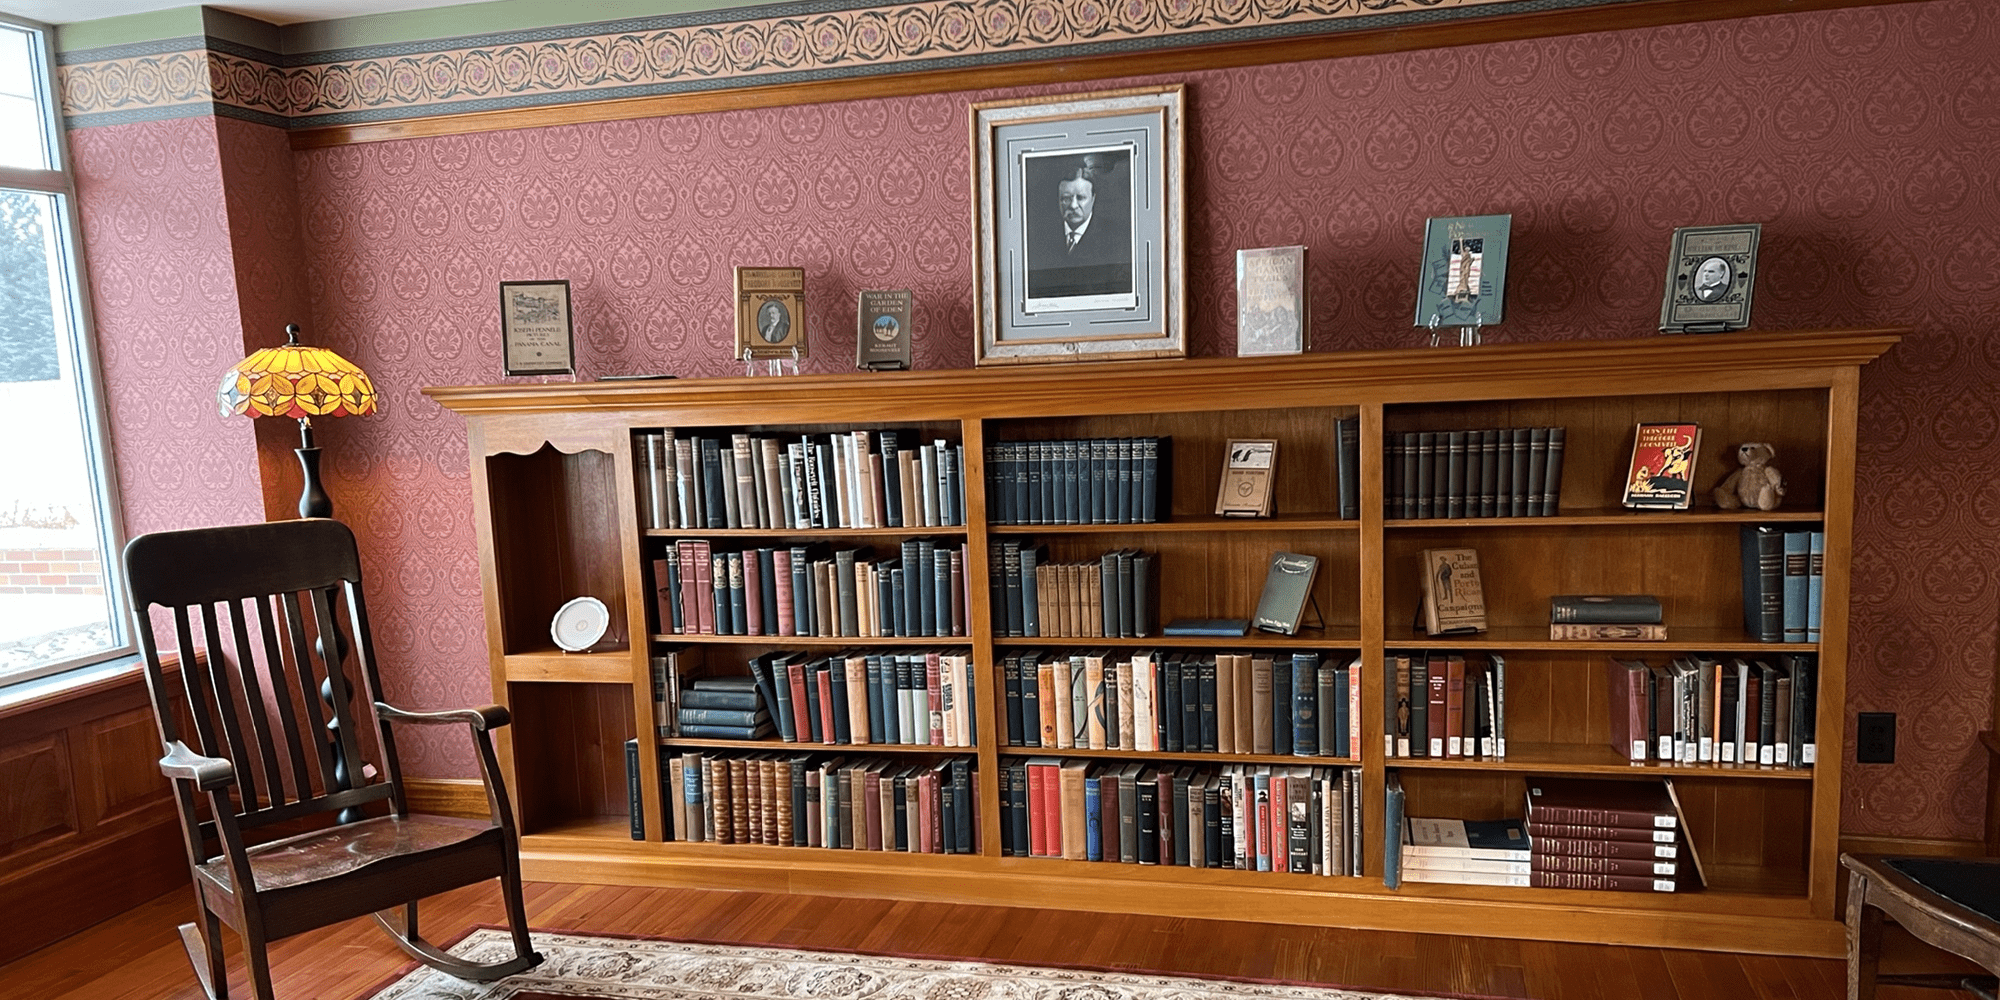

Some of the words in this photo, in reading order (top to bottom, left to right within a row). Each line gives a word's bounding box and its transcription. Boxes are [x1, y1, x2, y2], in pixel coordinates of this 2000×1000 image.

[1248, 257, 1294, 267] AFRICAN
[808, 456, 818, 486] Roosevelt
[1455, 588, 1480, 602] Rican
